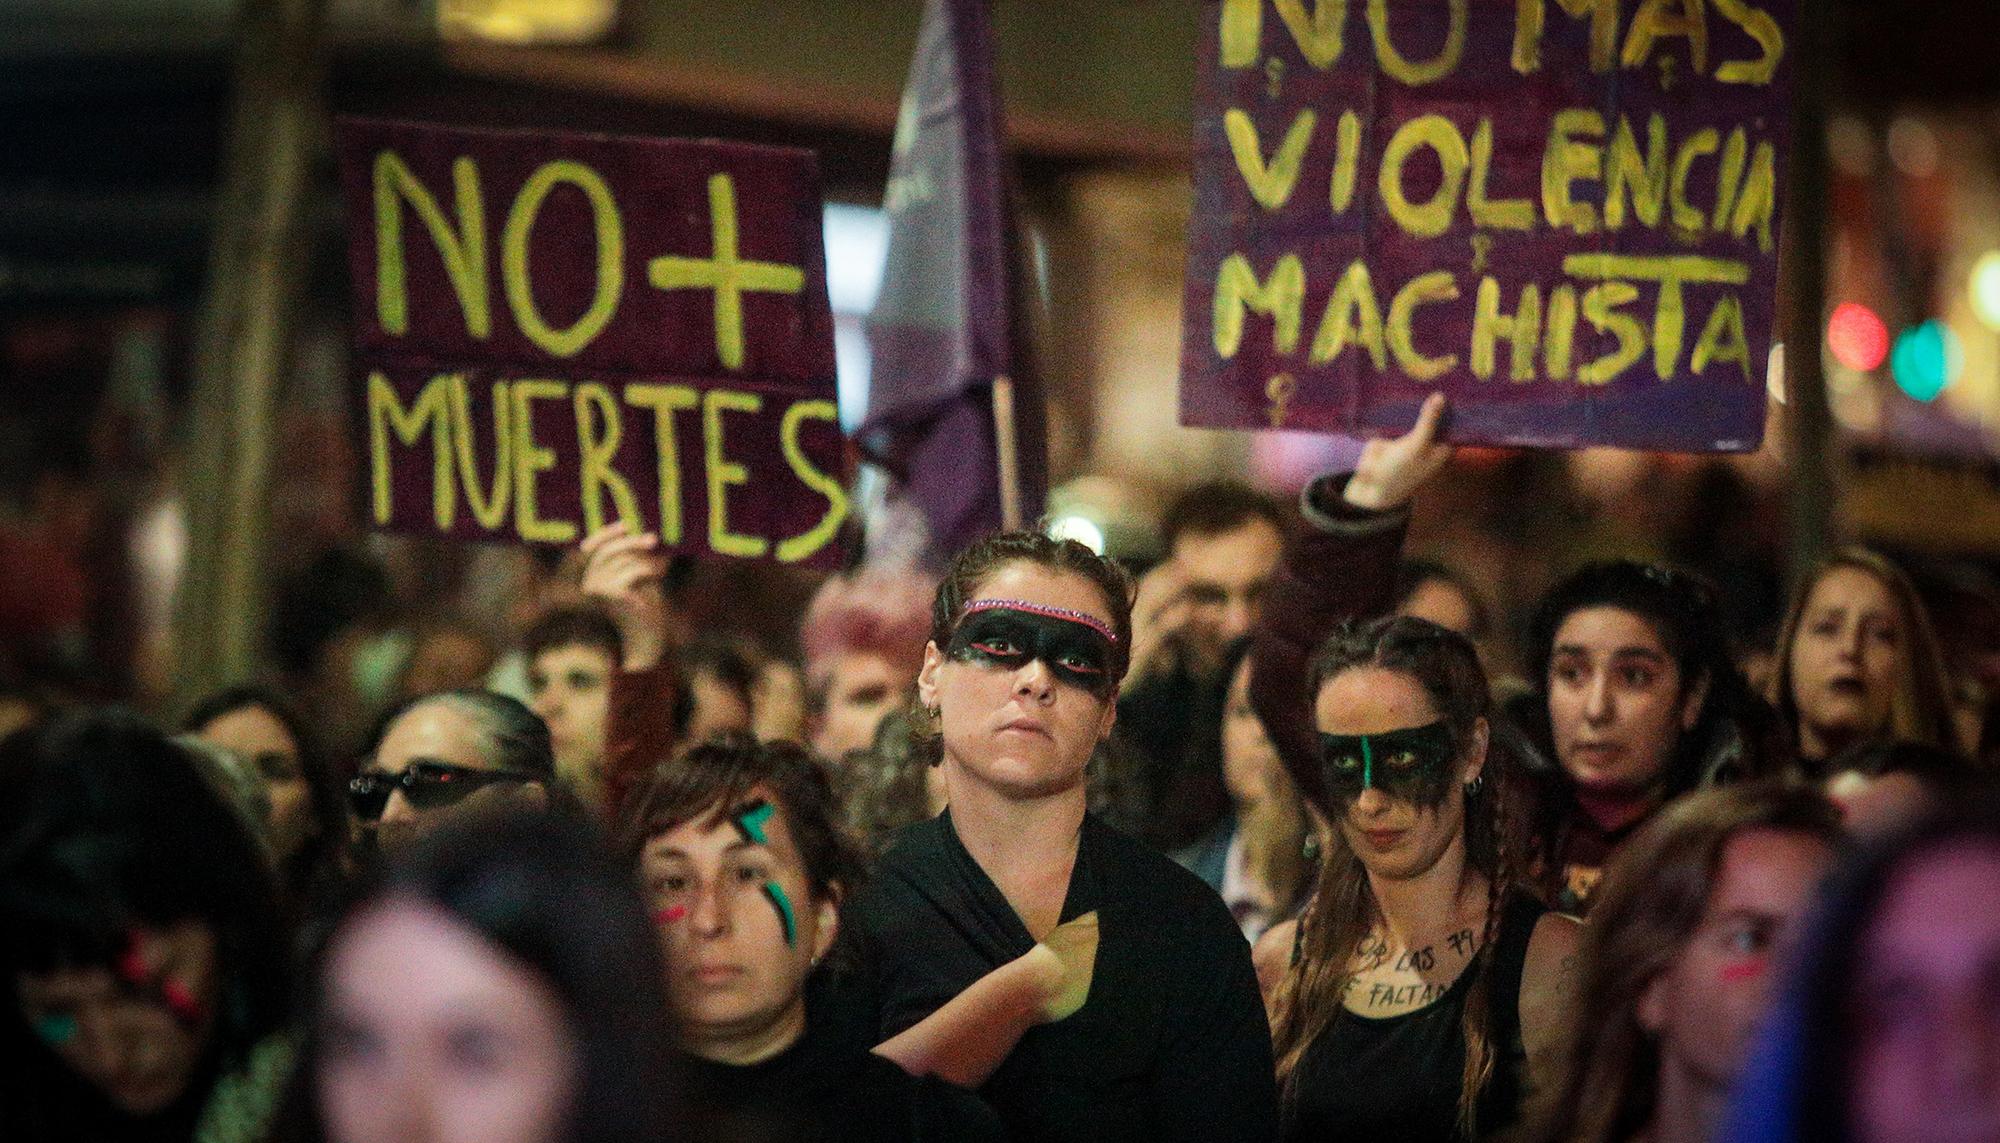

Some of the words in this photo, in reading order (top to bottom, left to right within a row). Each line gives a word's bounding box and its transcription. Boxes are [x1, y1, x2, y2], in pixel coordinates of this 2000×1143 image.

[1218, 0, 1467, 85] NO
[1224, 109, 1776, 253] VIOLENCIA
[373, 151, 624, 357] NO
[648, 172, 805, 369] +
[1214, 253, 1751, 386] MACHISTA
[368, 373, 850, 562] MUERTES
[1395, 946, 1434, 972] LAS
